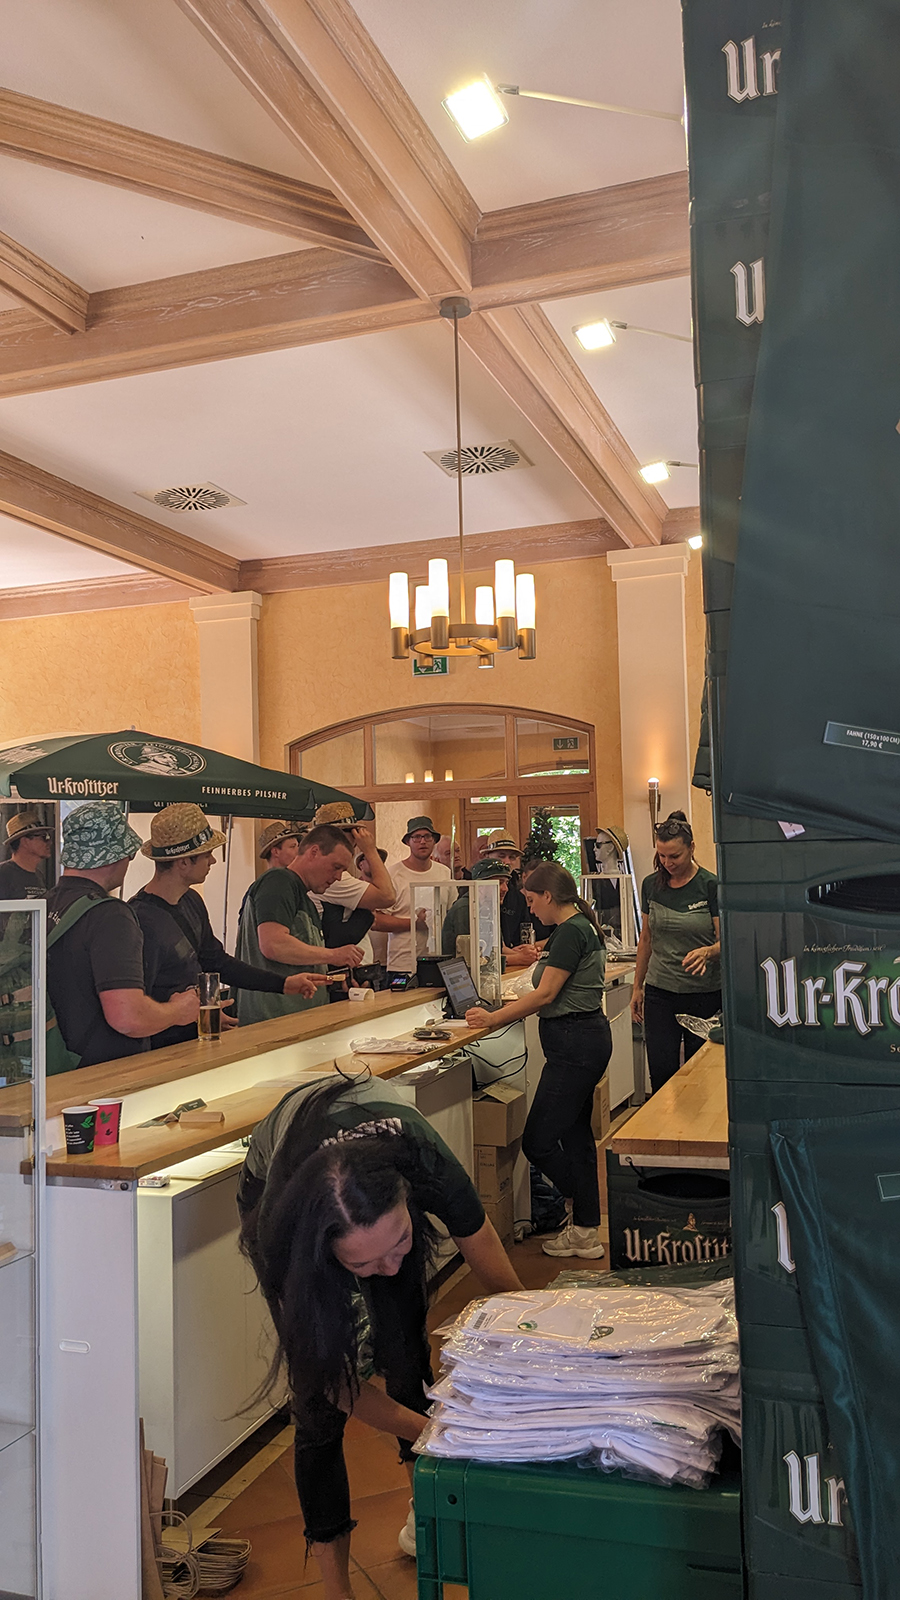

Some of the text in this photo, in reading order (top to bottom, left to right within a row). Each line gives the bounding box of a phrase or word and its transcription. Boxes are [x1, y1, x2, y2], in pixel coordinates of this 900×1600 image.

[846, 730, 864, 738] FAHNE
[862, 740, 878, 748] 17,90
[201, 786, 288, 800] FEINHERBES PILSNER
